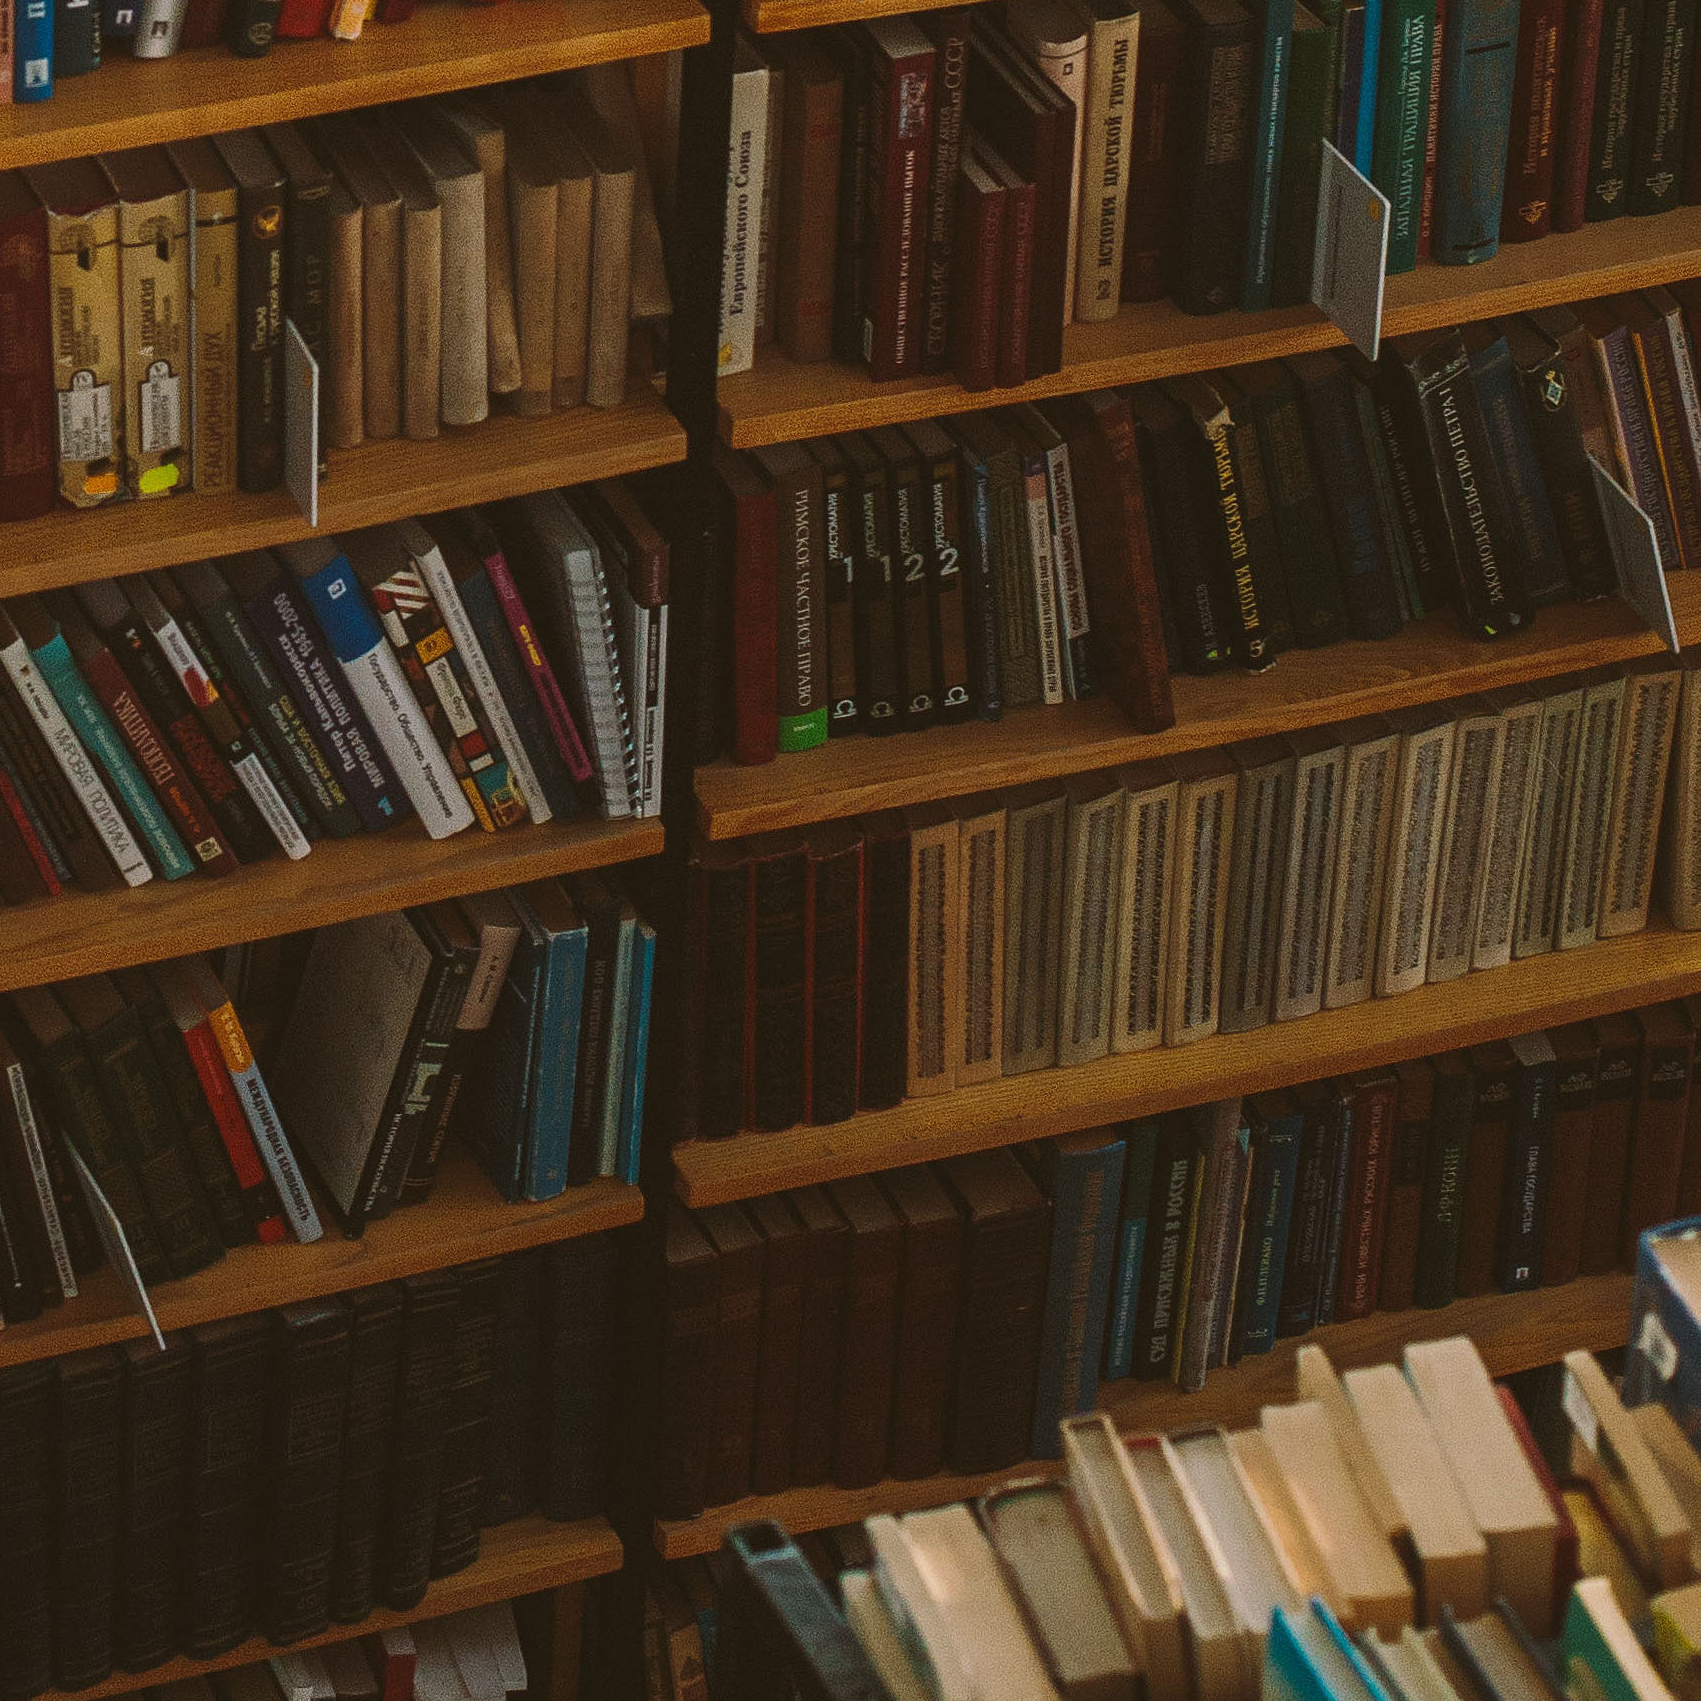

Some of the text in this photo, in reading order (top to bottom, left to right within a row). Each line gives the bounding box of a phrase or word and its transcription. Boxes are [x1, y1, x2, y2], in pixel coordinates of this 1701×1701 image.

[730, 130, 752, 315] Европейского Союза
[1095, 38, 1131, 269] ИСТОРИЯ ЦАРСКОЙ ТЮРЬМЫ
[200, 331, 225, 490] РЕАКЦИОННЫЙ ДУХ
[1439, 394, 1471, 446] ПЕТРА
[1455, 448, 1505, 605] ЗАКОНОДАТЕЛЬСТВО
[795, 489, 812, 706] РИМСКОЕ ЧАСТНОЕ ПРАВО
[114, 690, 177, 785] ГЕОПОЛИТИКА
[277, 634, 354, 773] Питер Кальвокоресси
[1165, 1158, 1188, 1216] РОССИИ
[1151, 1334, 1170, 1364] СУД
[1152, 1234, 1181, 1328] ПРИСЯЖНЫХ
